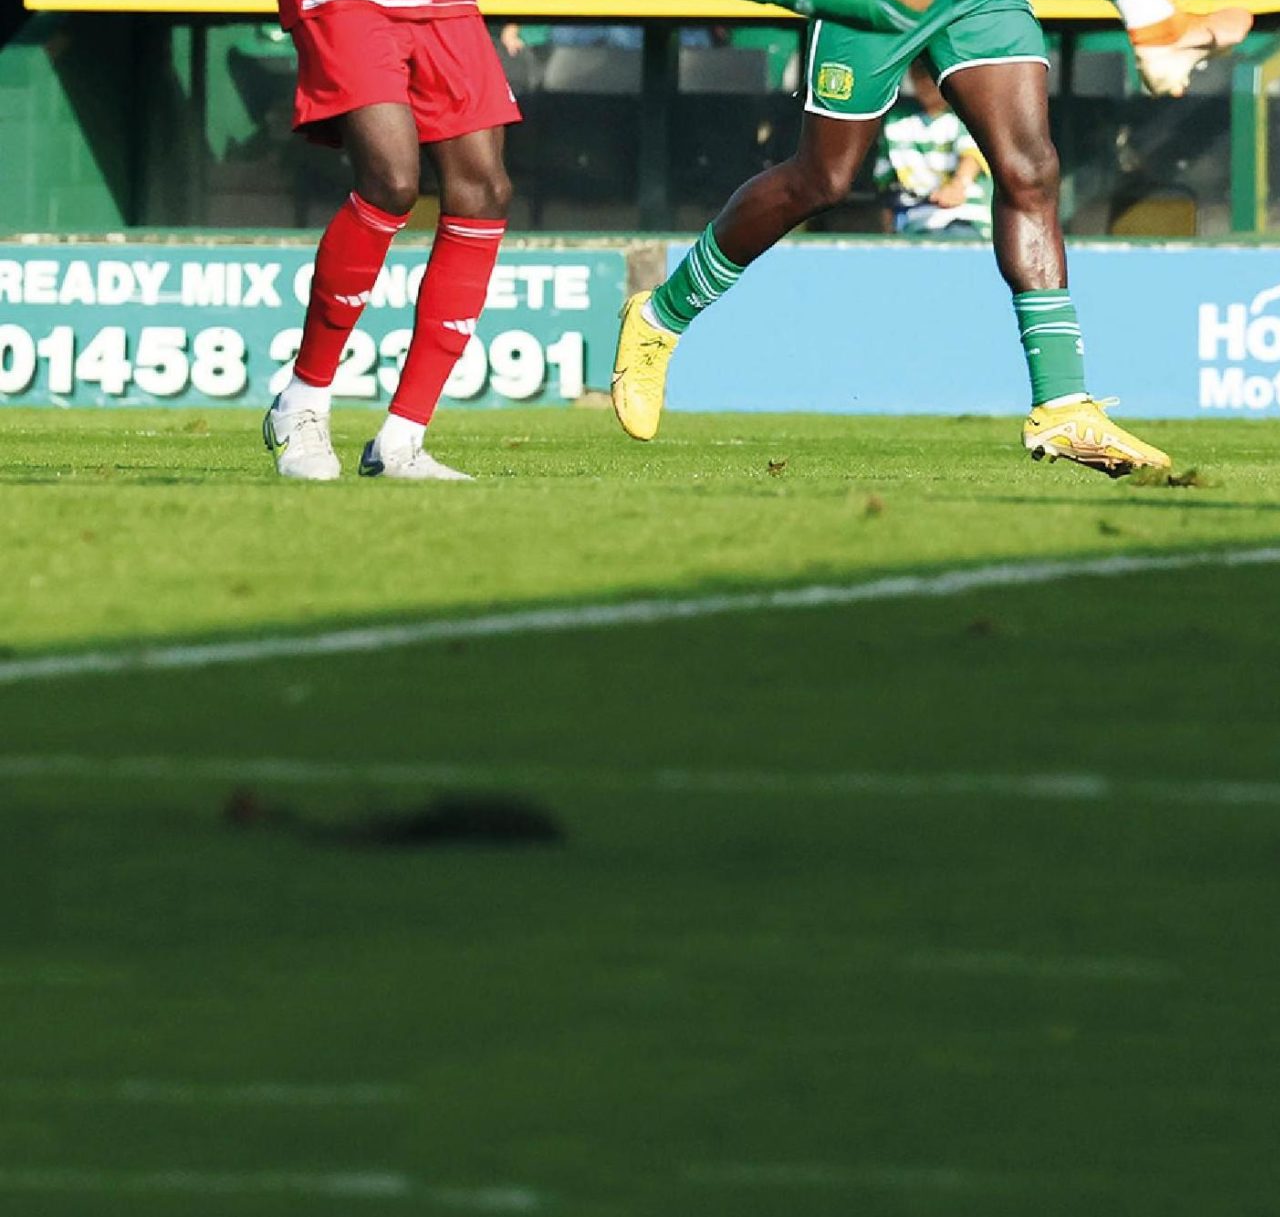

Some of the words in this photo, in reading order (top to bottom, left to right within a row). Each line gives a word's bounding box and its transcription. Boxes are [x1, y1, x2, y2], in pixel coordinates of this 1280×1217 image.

[0, 260, 170, 306] READY
[180, 262, 283, 307] MIX
[293, 263, 591, 309] CNETE
[0, 324, 248, 397] 01458
